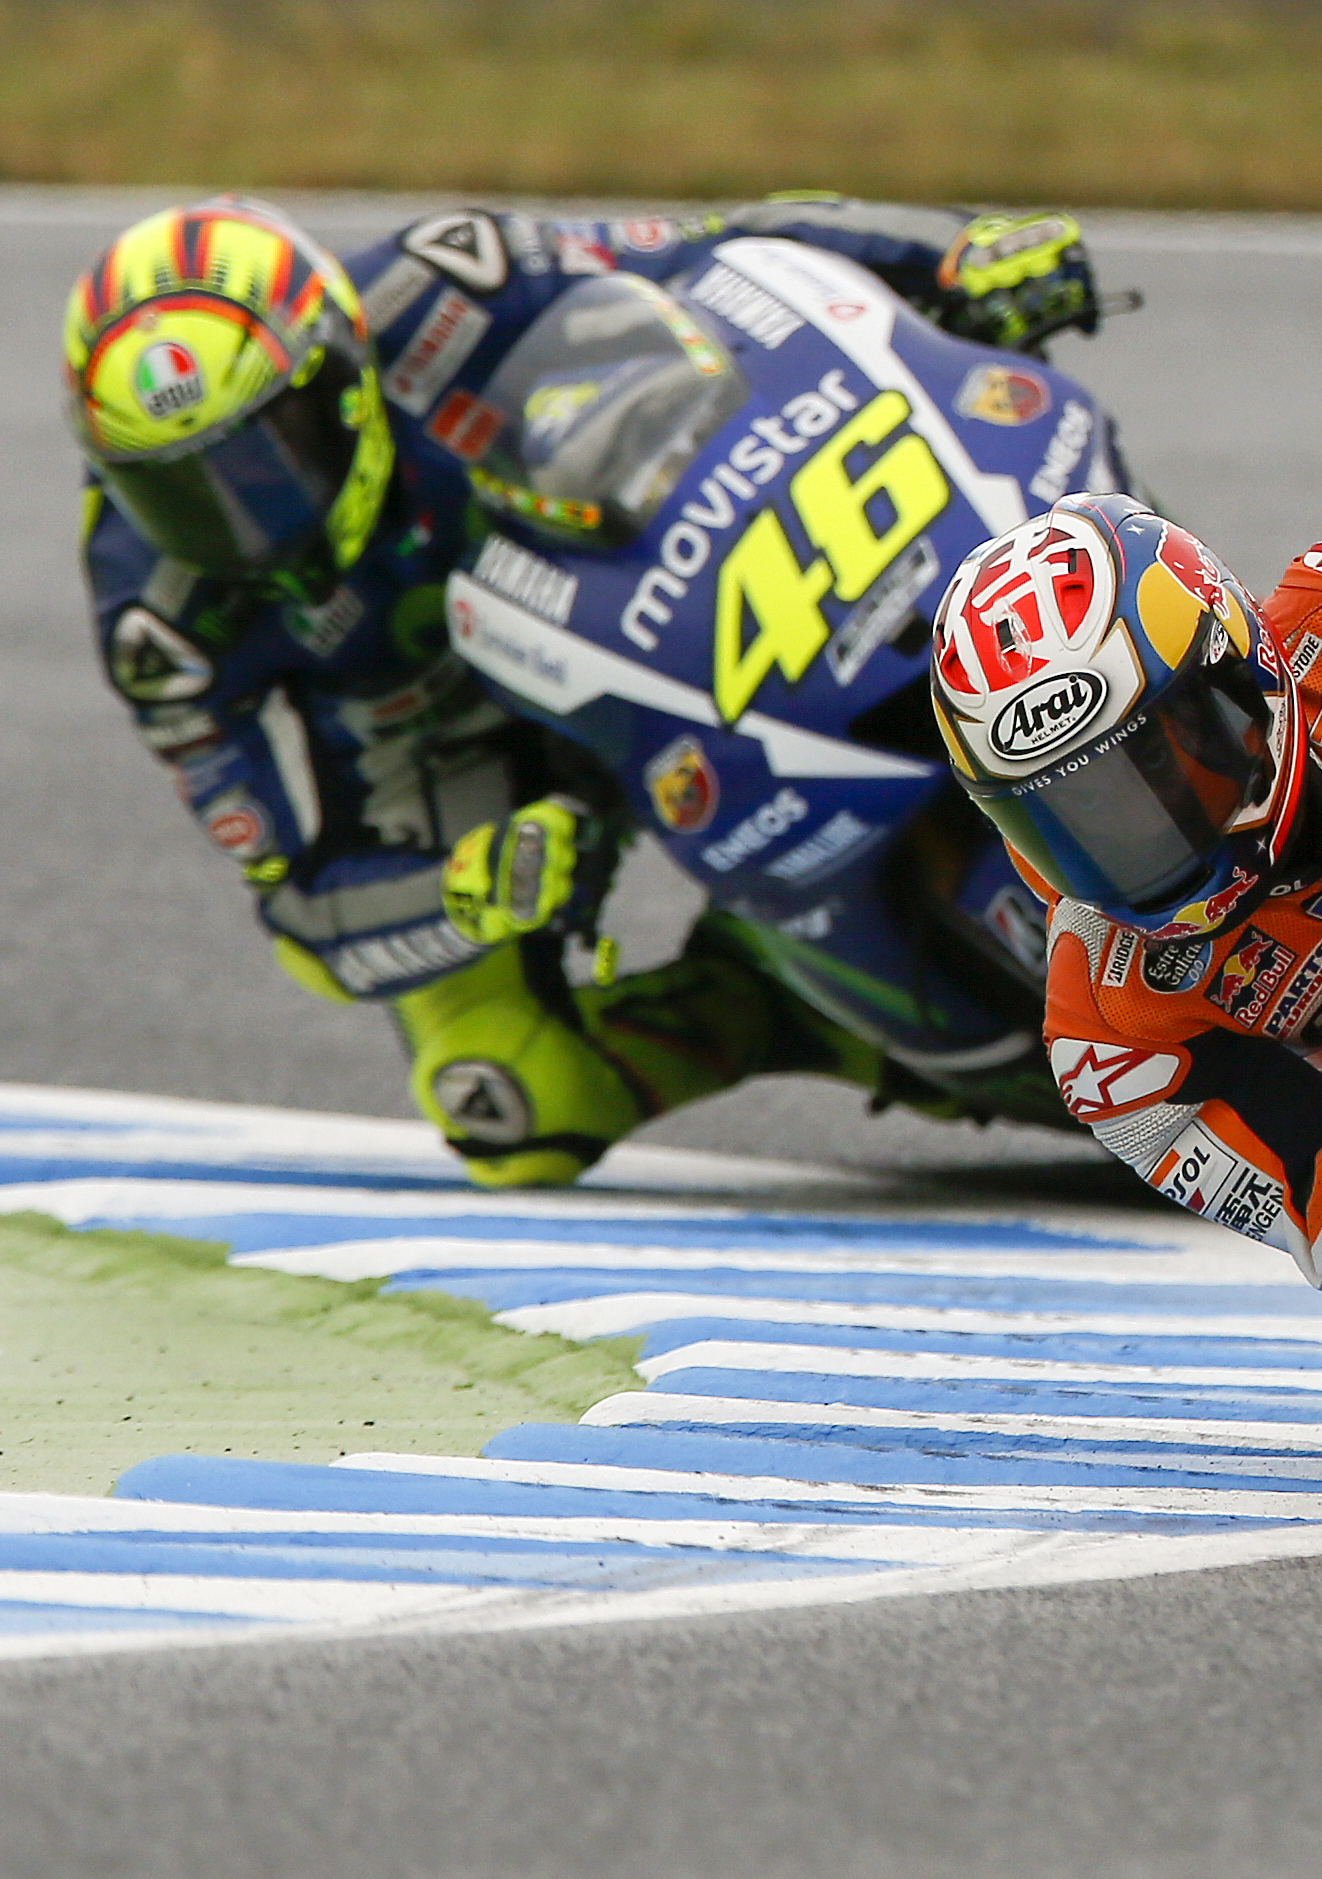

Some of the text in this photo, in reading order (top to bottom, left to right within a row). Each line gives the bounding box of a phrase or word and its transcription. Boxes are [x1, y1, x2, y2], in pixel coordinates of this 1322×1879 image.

[619, 368, 858, 653] movistar
[713, 390, 950, 722] 46
[1003, 673, 1088, 751] Arai
[1011, 713, 1147, 796] GIVES YOU WINGS
